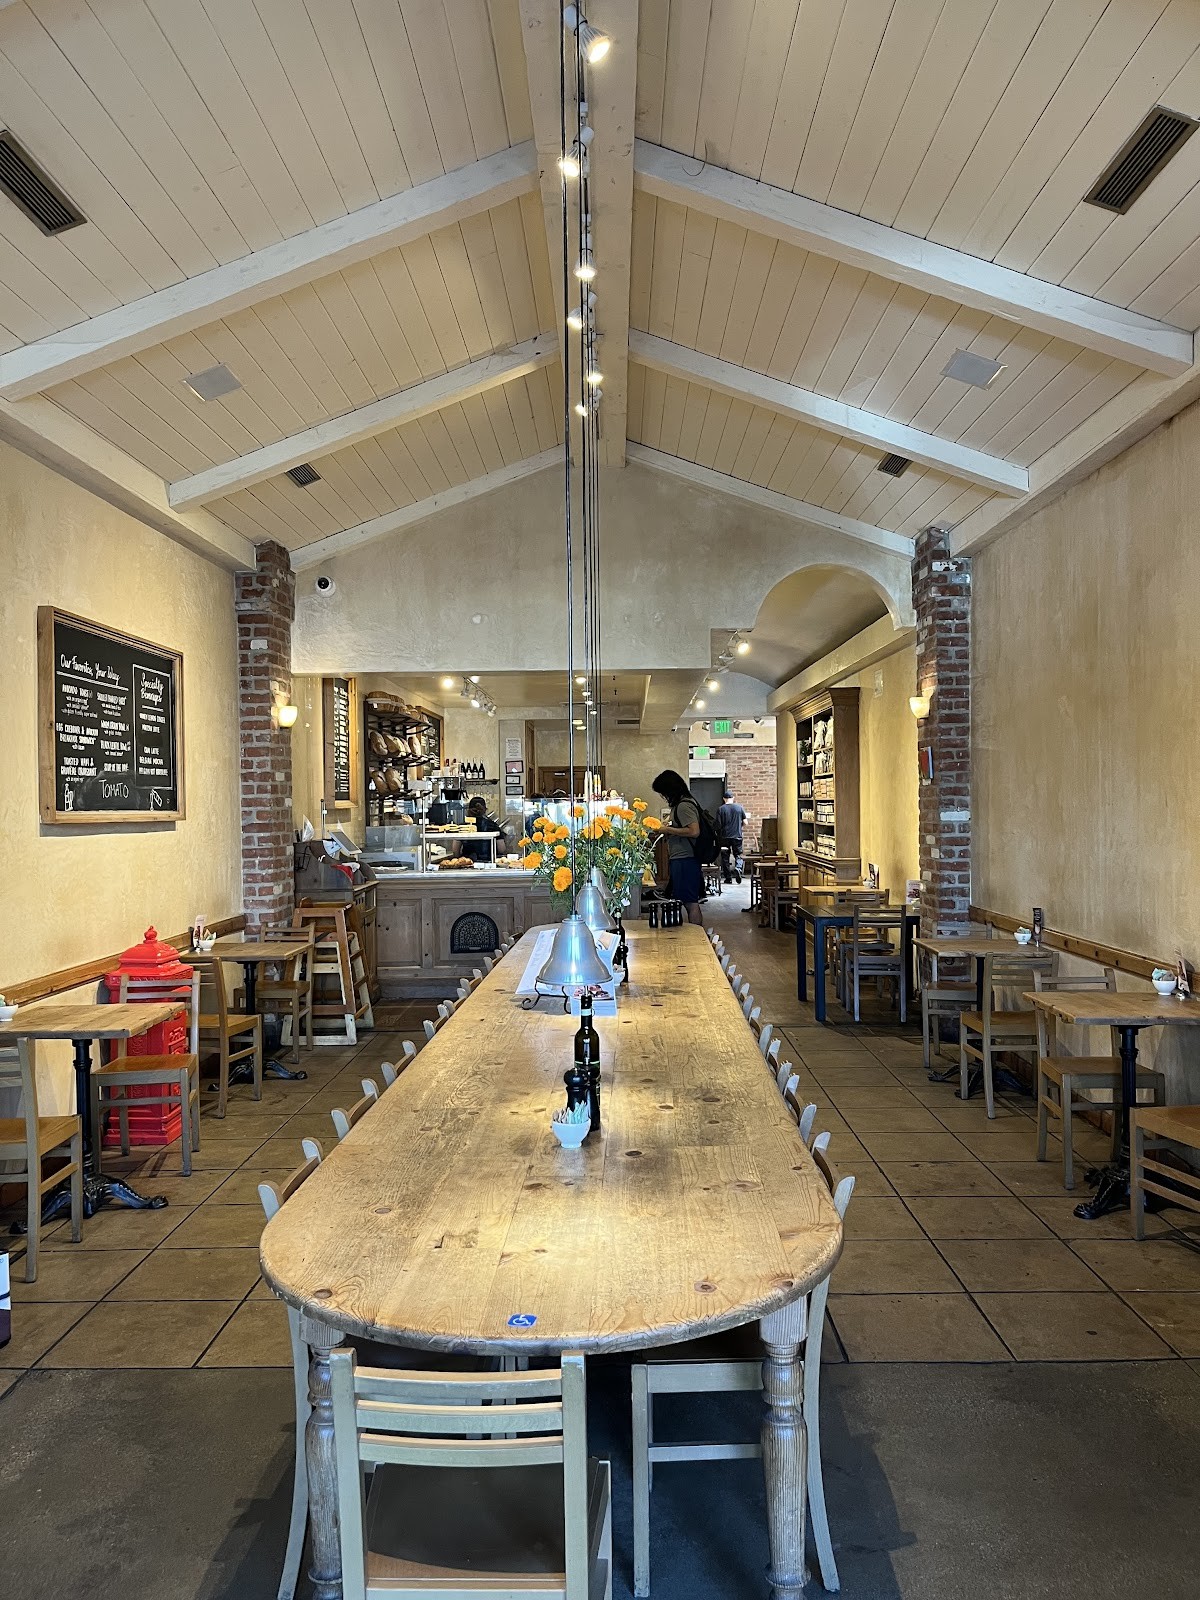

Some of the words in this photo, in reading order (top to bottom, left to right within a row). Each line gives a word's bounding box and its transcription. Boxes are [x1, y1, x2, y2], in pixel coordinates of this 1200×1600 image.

[61, 653, 72, 669] Our
[95, 662, 107, 679] Your
[714, 720, 731, 734] EXIT
[99, 779, 129, 799] TOMATO
